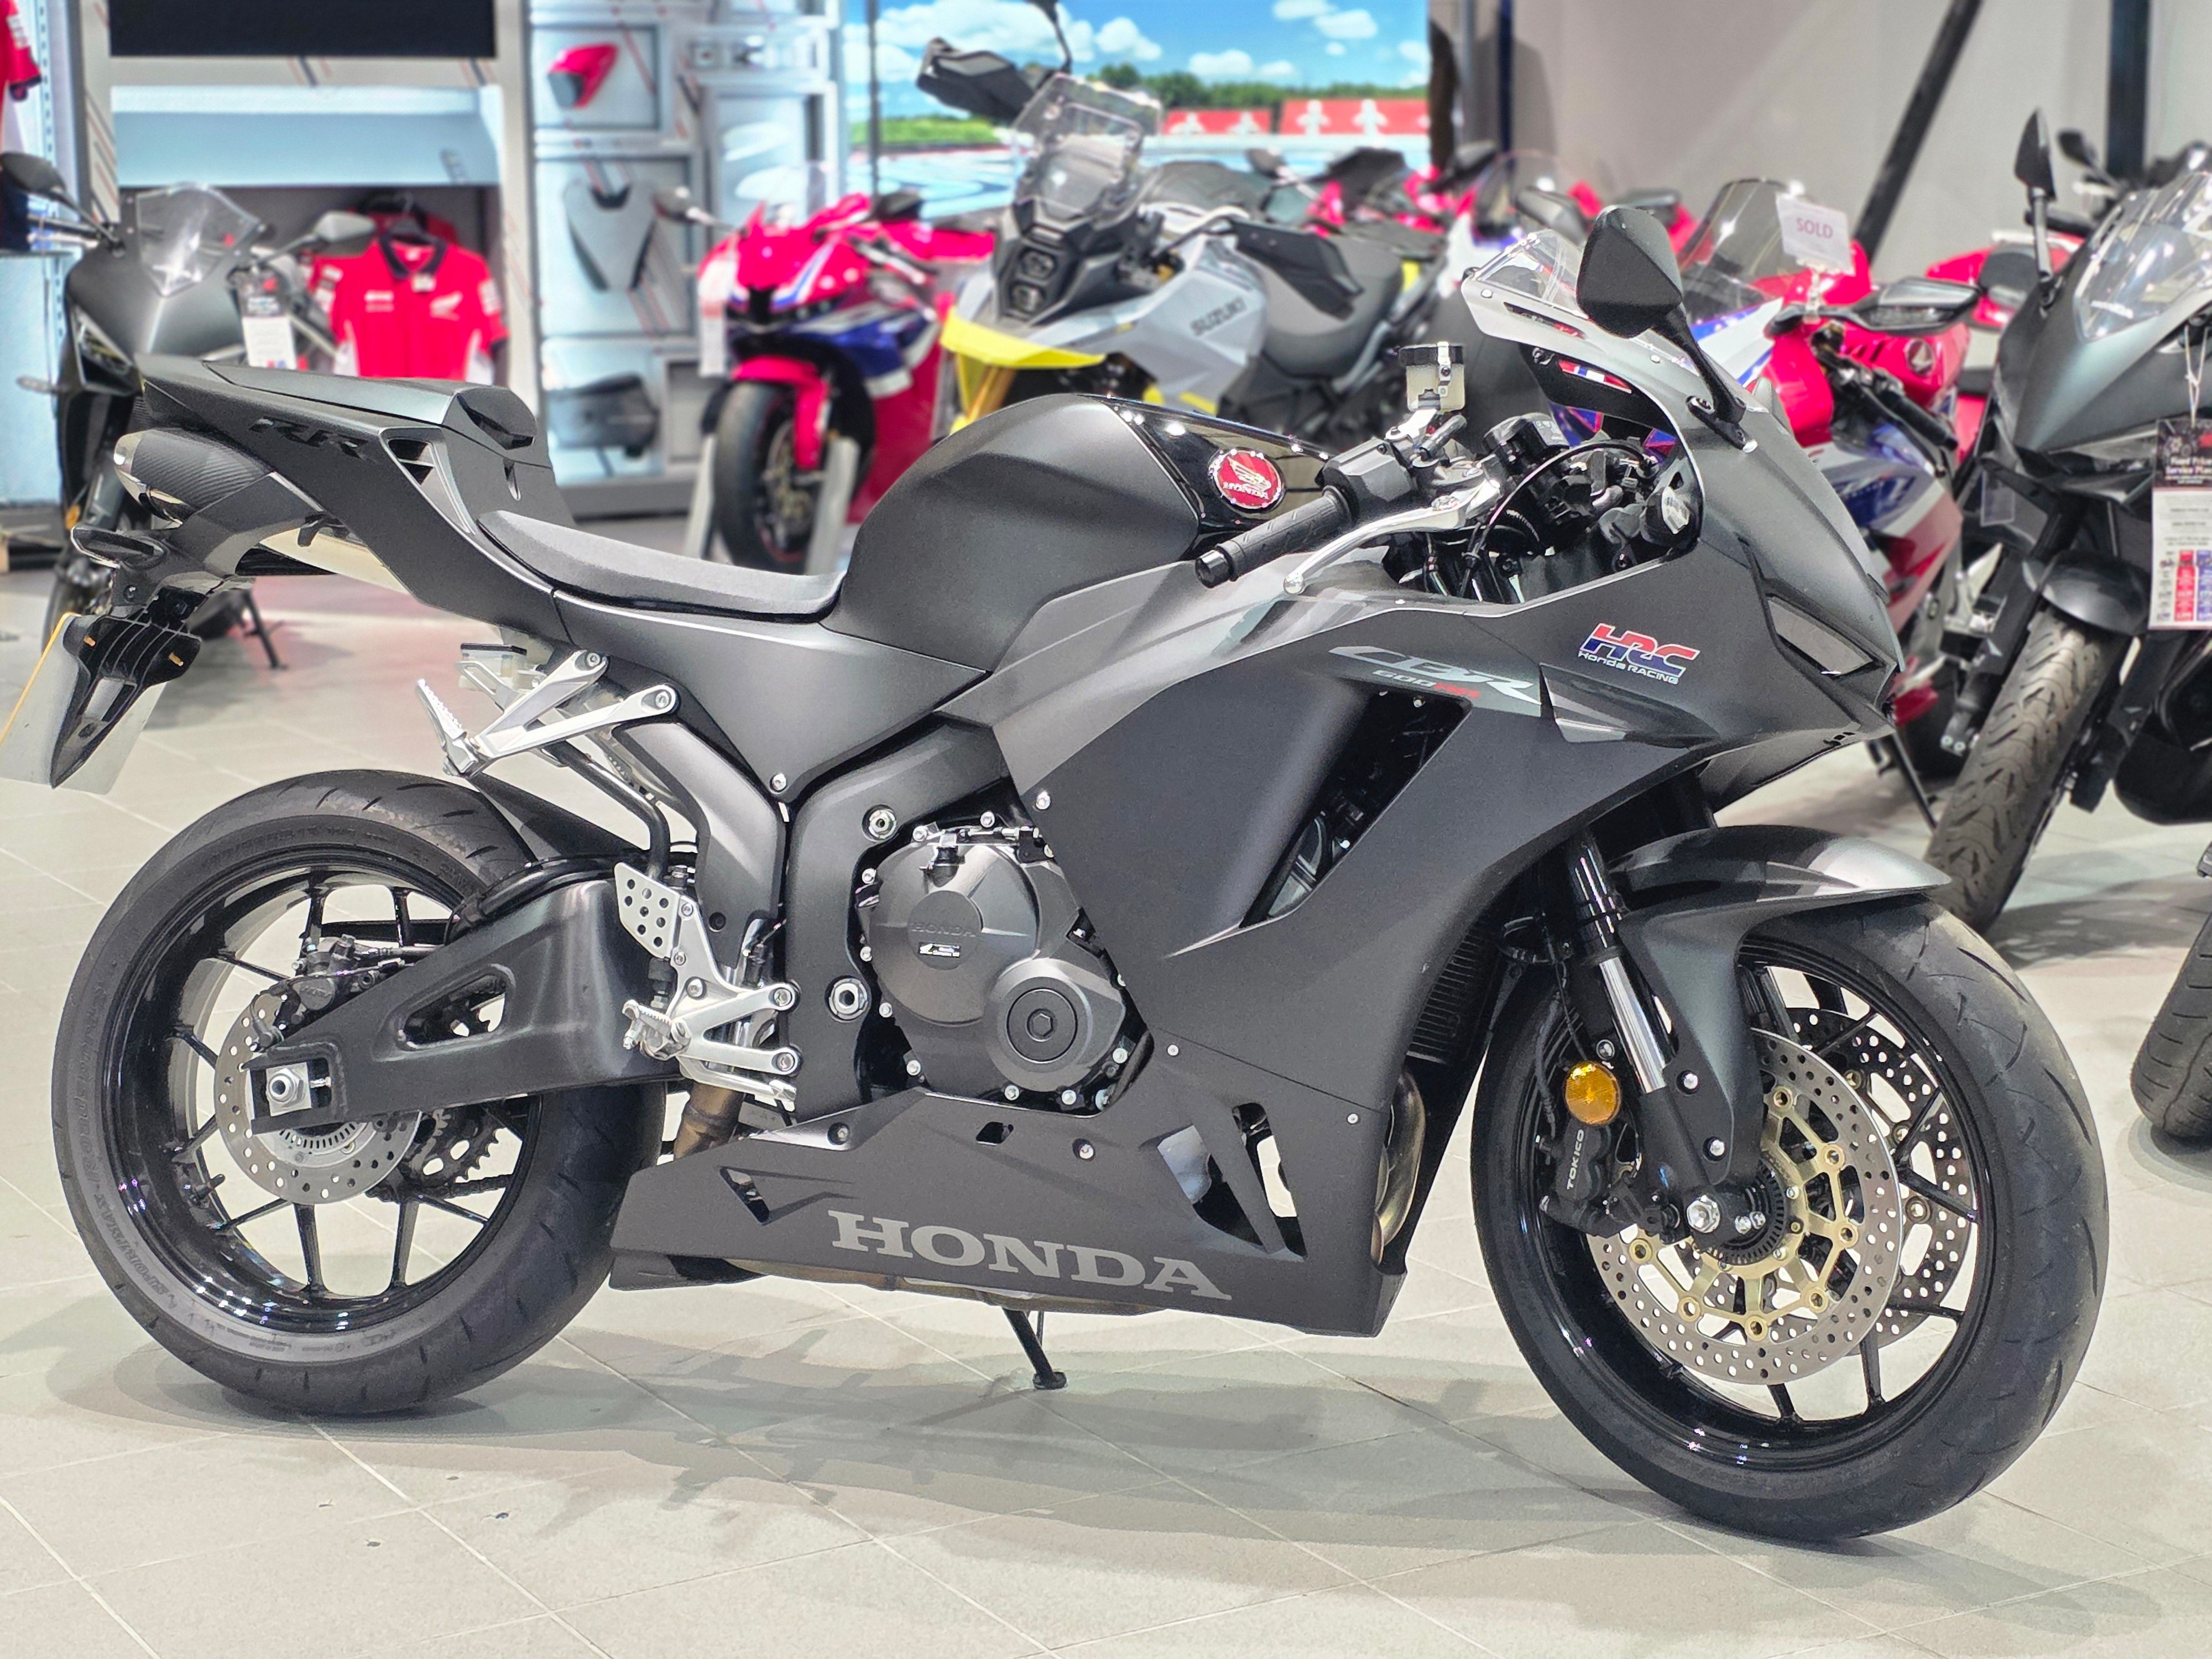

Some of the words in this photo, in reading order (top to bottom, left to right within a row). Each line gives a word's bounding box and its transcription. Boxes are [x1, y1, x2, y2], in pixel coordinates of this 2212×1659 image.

[1796, 217, 1834, 239] SOLD
[1190, 296, 1247, 337] SUZUKI
[1579, 623, 1700, 678] HRC
[1627, 664, 1679, 685] RACING
[1328, 645, 1541, 706] CBR
[910, 921, 976, 937] HONDA
[1567, 1129, 1584, 1190] TOKICO
[827, 1209, 1233, 1301] HONDA
